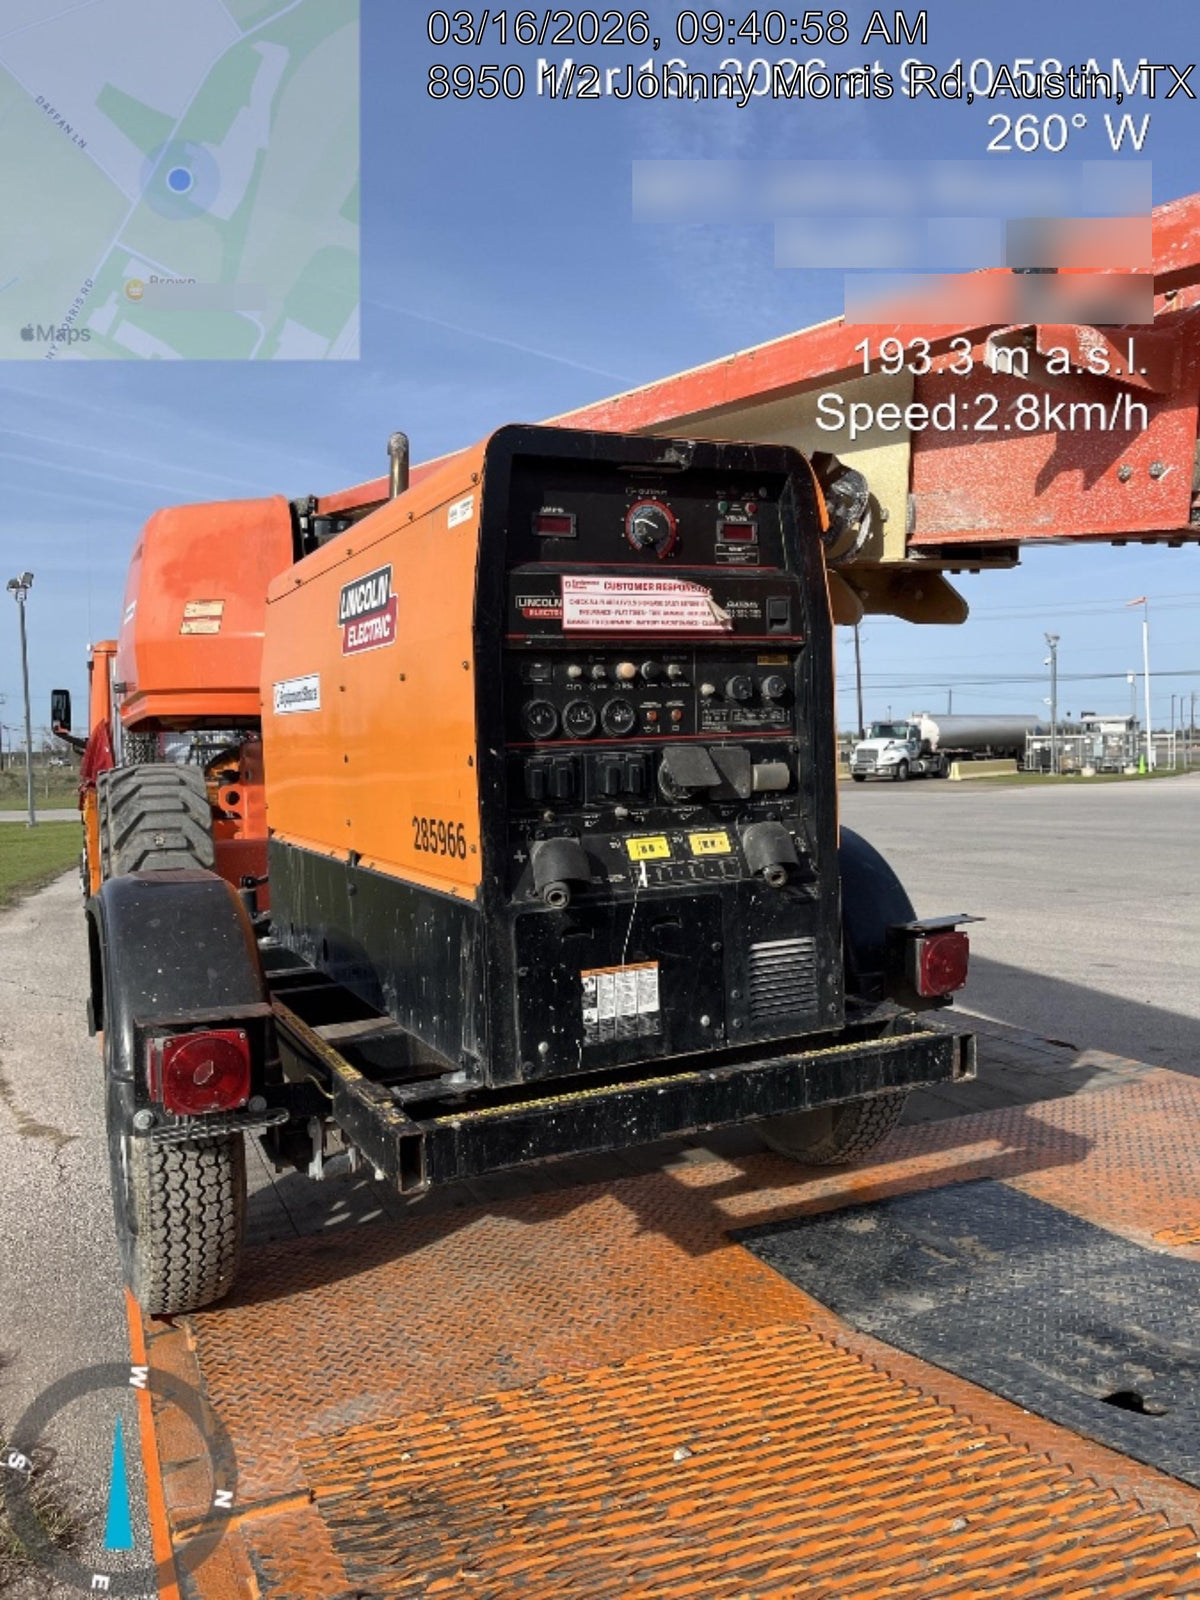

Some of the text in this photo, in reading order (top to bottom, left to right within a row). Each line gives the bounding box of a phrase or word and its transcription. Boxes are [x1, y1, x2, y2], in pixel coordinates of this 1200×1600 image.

[341, 574, 389, 619] LINCOLN
[604, 582, 655, 591] CUSTOMER
[519, 598, 562, 607] LINCOLN
[529, 608, 562, 616] ELECTR
[347, 614, 392, 648] ELECTRIC
[411, 815, 466, 860] 285966
